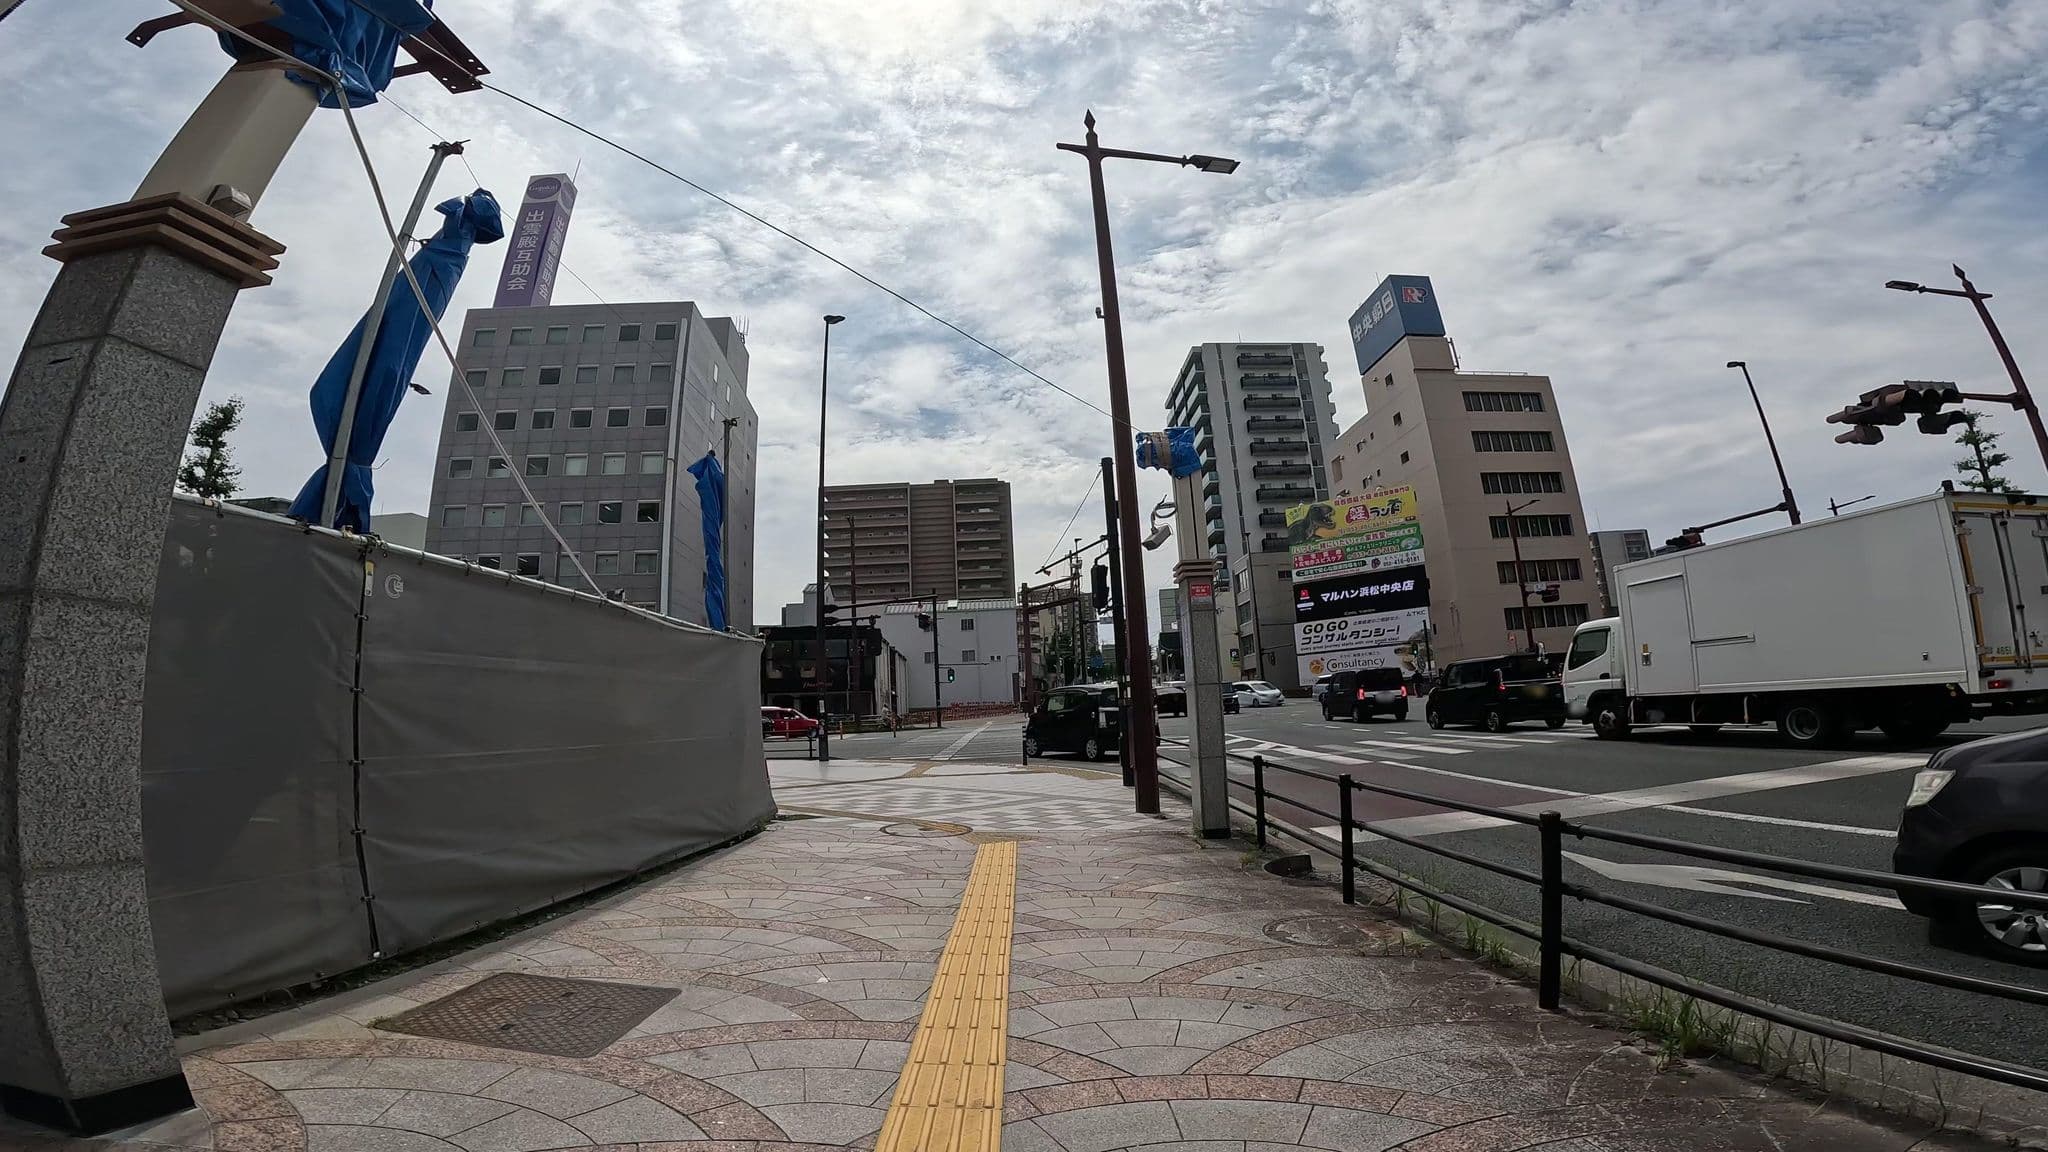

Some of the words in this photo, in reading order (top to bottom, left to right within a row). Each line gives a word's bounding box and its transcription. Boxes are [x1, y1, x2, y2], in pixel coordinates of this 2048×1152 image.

[507, 209, 545, 291] 出雲殿互助会
[1353, 290, 1394, 342] 中央朝日
[1320, 579, 1415, 602] マルハン浜松中央店
[1301, 625, 1401, 645] コンサルタンシー!
[1326, 657, 1386, 673] Consultancy
